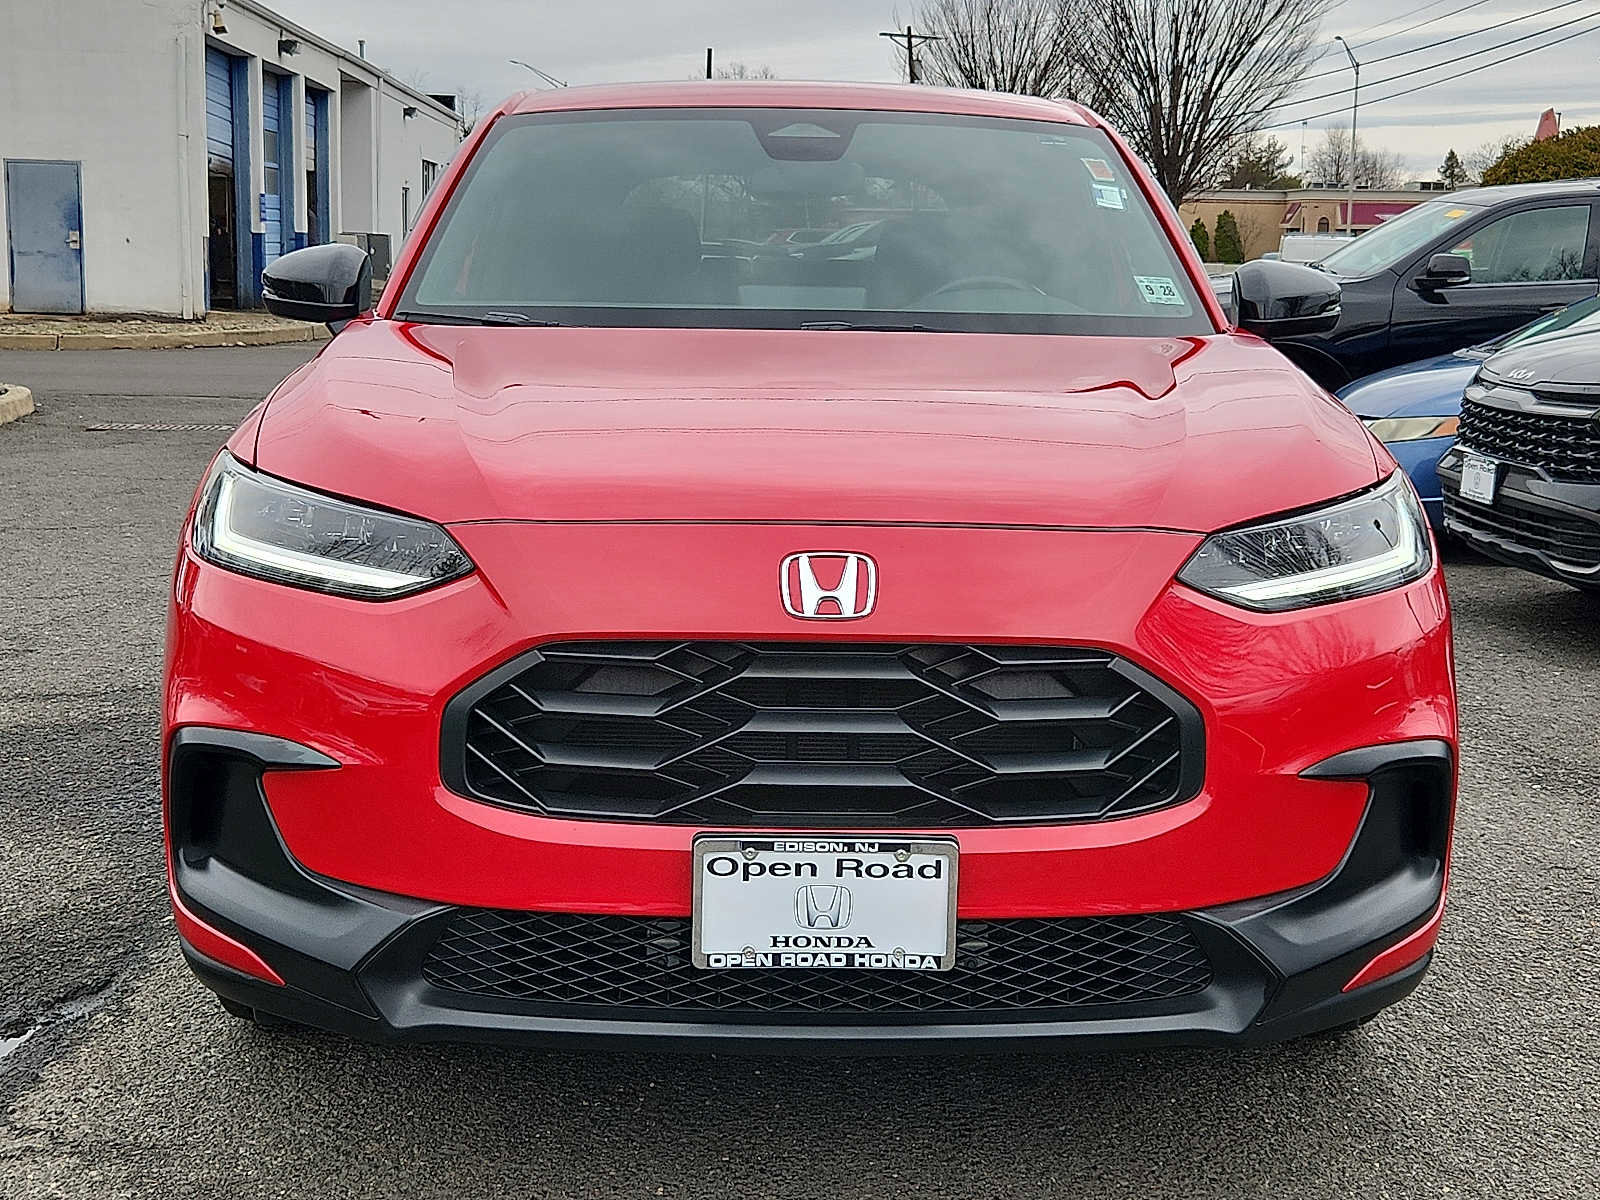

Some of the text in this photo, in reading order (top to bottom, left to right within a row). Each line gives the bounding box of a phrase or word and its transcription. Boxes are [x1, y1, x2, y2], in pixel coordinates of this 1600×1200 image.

[1144, 285, 1175, 296] 9 28
[773, 842, 879, 853] EDISON, NJ
[706, 856, 942, 882] Open Road
[769, 935, 875, 949] HONDA
[710, 953, 938, 969] OPEN ROAD HONDA
